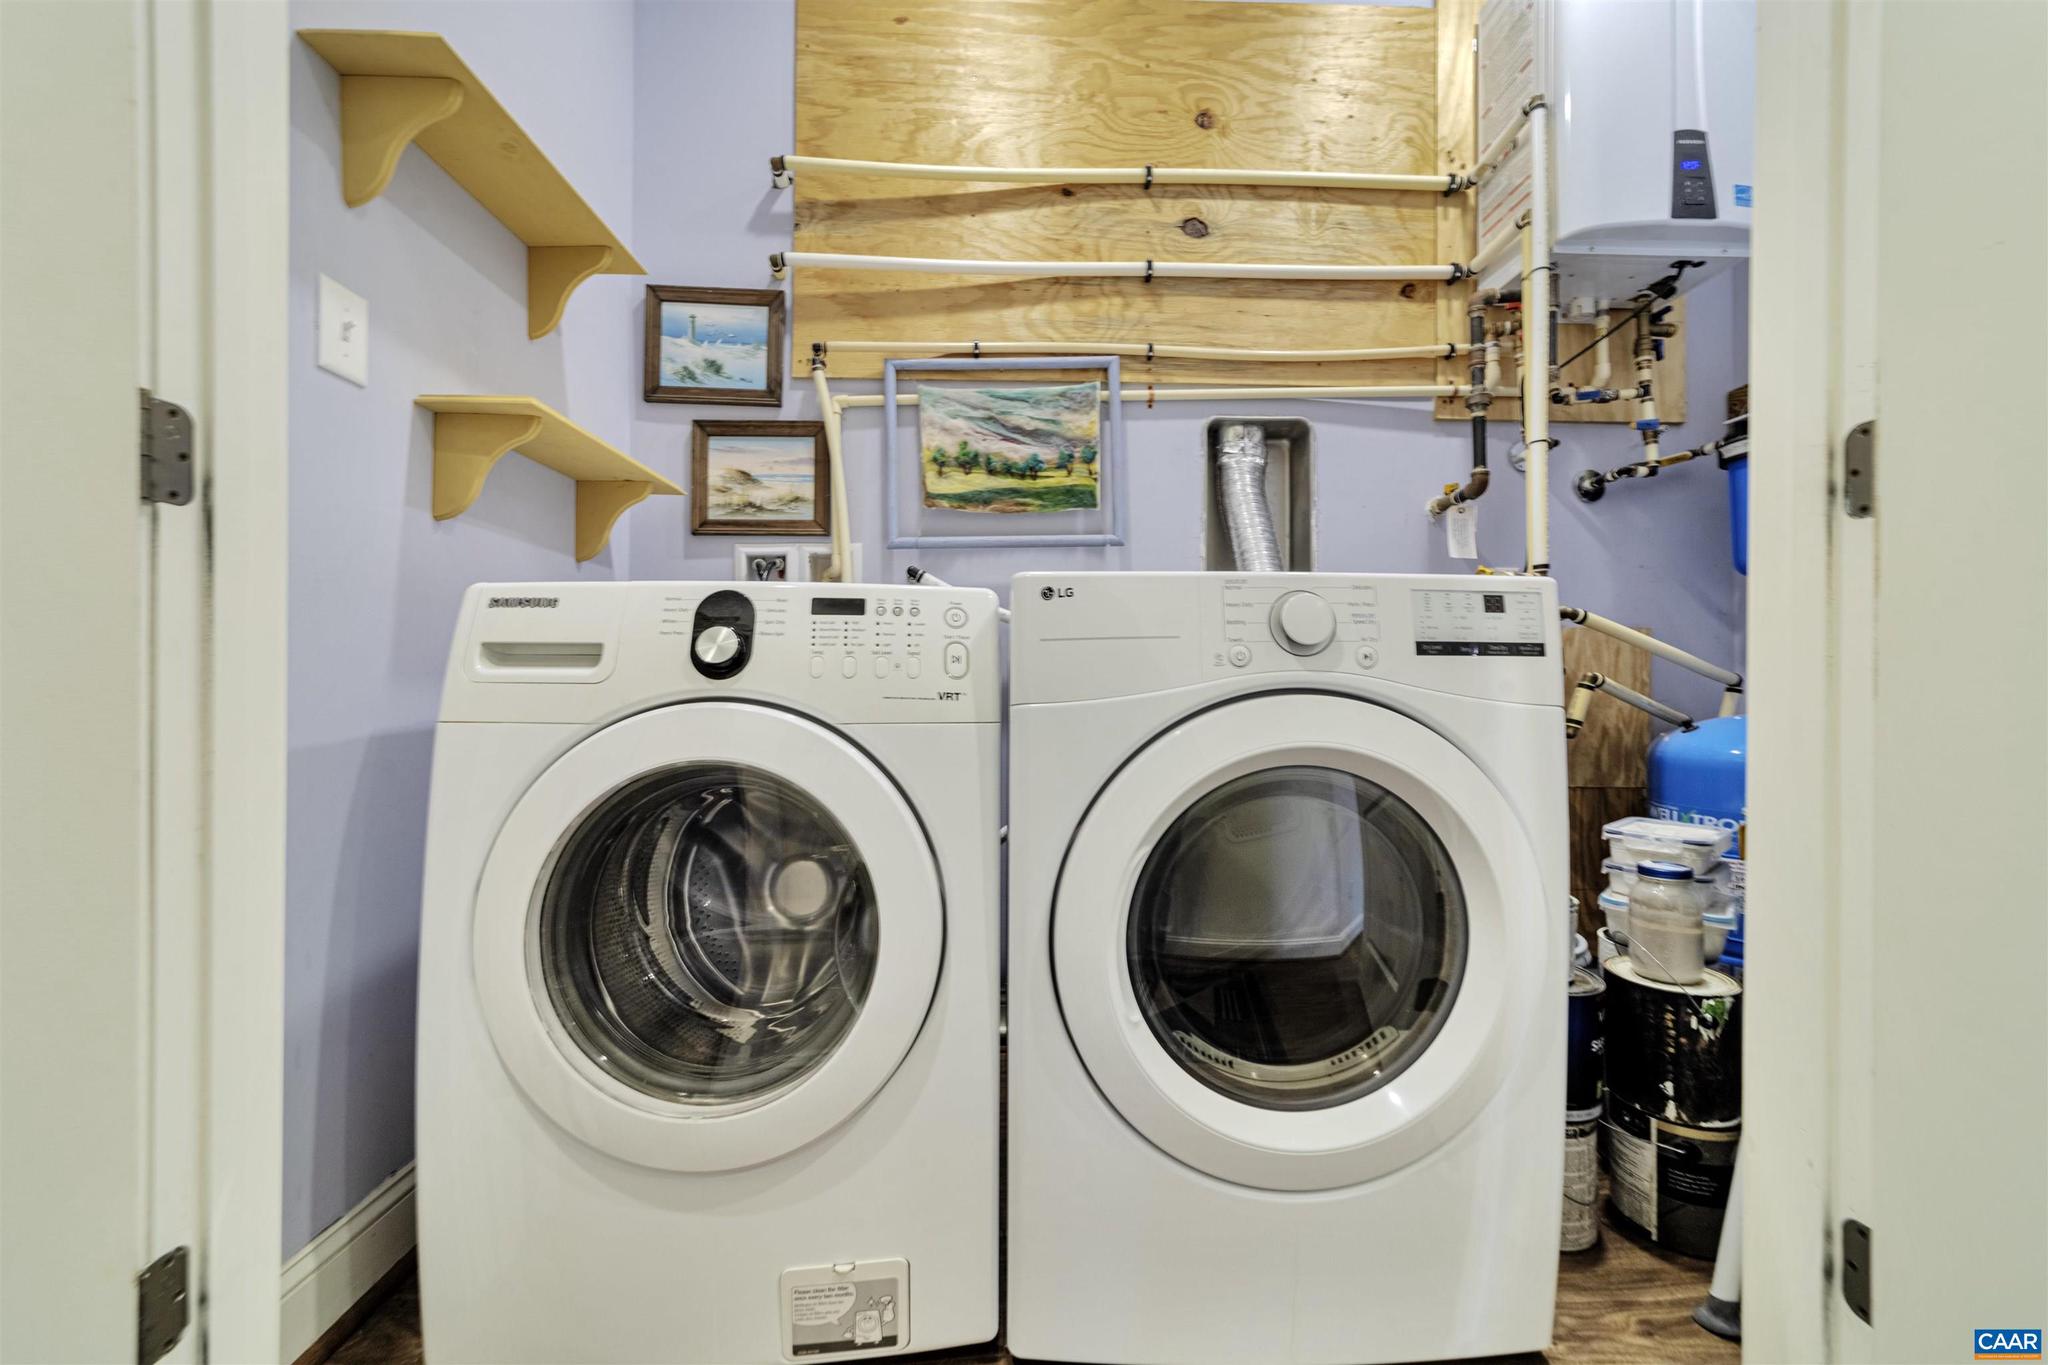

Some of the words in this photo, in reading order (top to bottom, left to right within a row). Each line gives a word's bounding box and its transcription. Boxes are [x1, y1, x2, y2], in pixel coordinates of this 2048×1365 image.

[1058, 587, 1074, 598] LG
[488, 597, 559, 608] SAMSUNG
[938, 692, 961, 701] VRT
